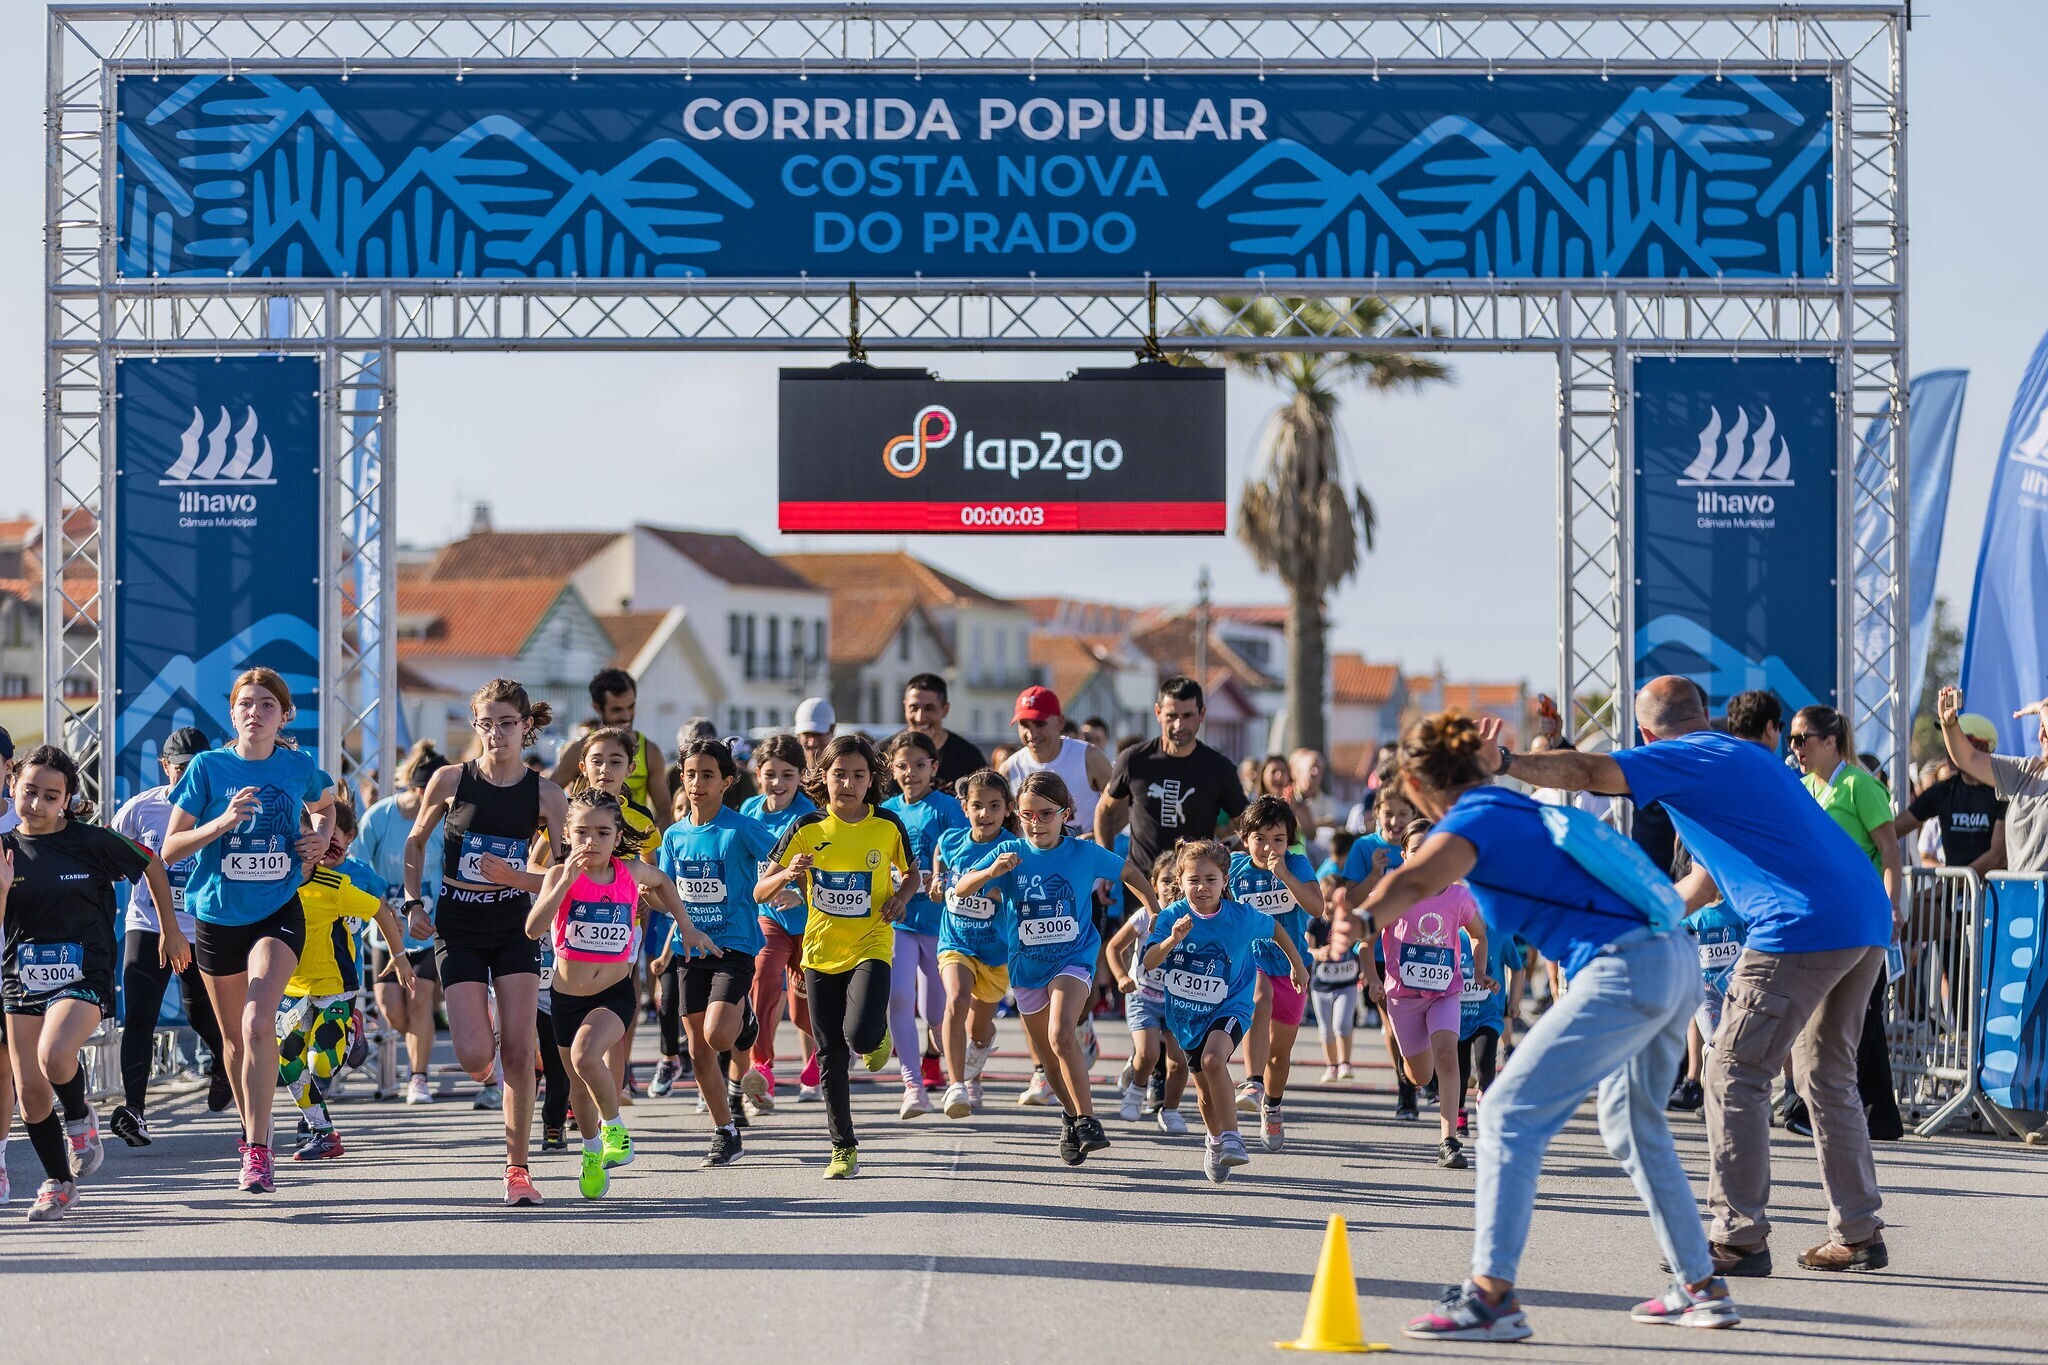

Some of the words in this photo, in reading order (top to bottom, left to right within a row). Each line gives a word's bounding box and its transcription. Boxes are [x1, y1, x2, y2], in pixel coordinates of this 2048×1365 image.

[683, 97, 960, 141] CORRIDA
[979, 97, 1268, 141] POPULAR
[781, 154, 979, 198] COSTA
[998, 154, 1169, 198] NOVA
[814, 211, 903, 254] DO
[924, 211, 1137, 254] PRADO
[963, 430, 1124, 480] lap2go
[215, 517, 258, 529] Municipal
[961, 506, 1045, 526] 00:00:03
[1733, 517, 1776, 530] Municipal
[231, 856, 243, 870] K
[248, 855, 285, 870] 3101
[468, 856, 479, 870] K
[686, 881, 719, 893] 3025
[452, 889, 497, 904] NIKE
[817, 888, 824, 902] K
[827, 892, 864, 906] 3096
[957, 896, 988, 911] 3031
[1256, 892, 1289, 907] 3016
[574, 924, 586, 938] K
[590, 926, 626, 941] 3022
[1024, 923, 1034, 935] K
[1037, 919, 1072, 934] 3006
[1707, 944, 1737, 958] 3043
[26, 967, 38, 980] K
[41, 967, 75, 980] 3004
[1406, 964, 1416, 977] K
[1419, 966, 1450, 981] 3036
[1173, 972, 1183, 986] K
[1184, 975, 1221, 993] 3017
